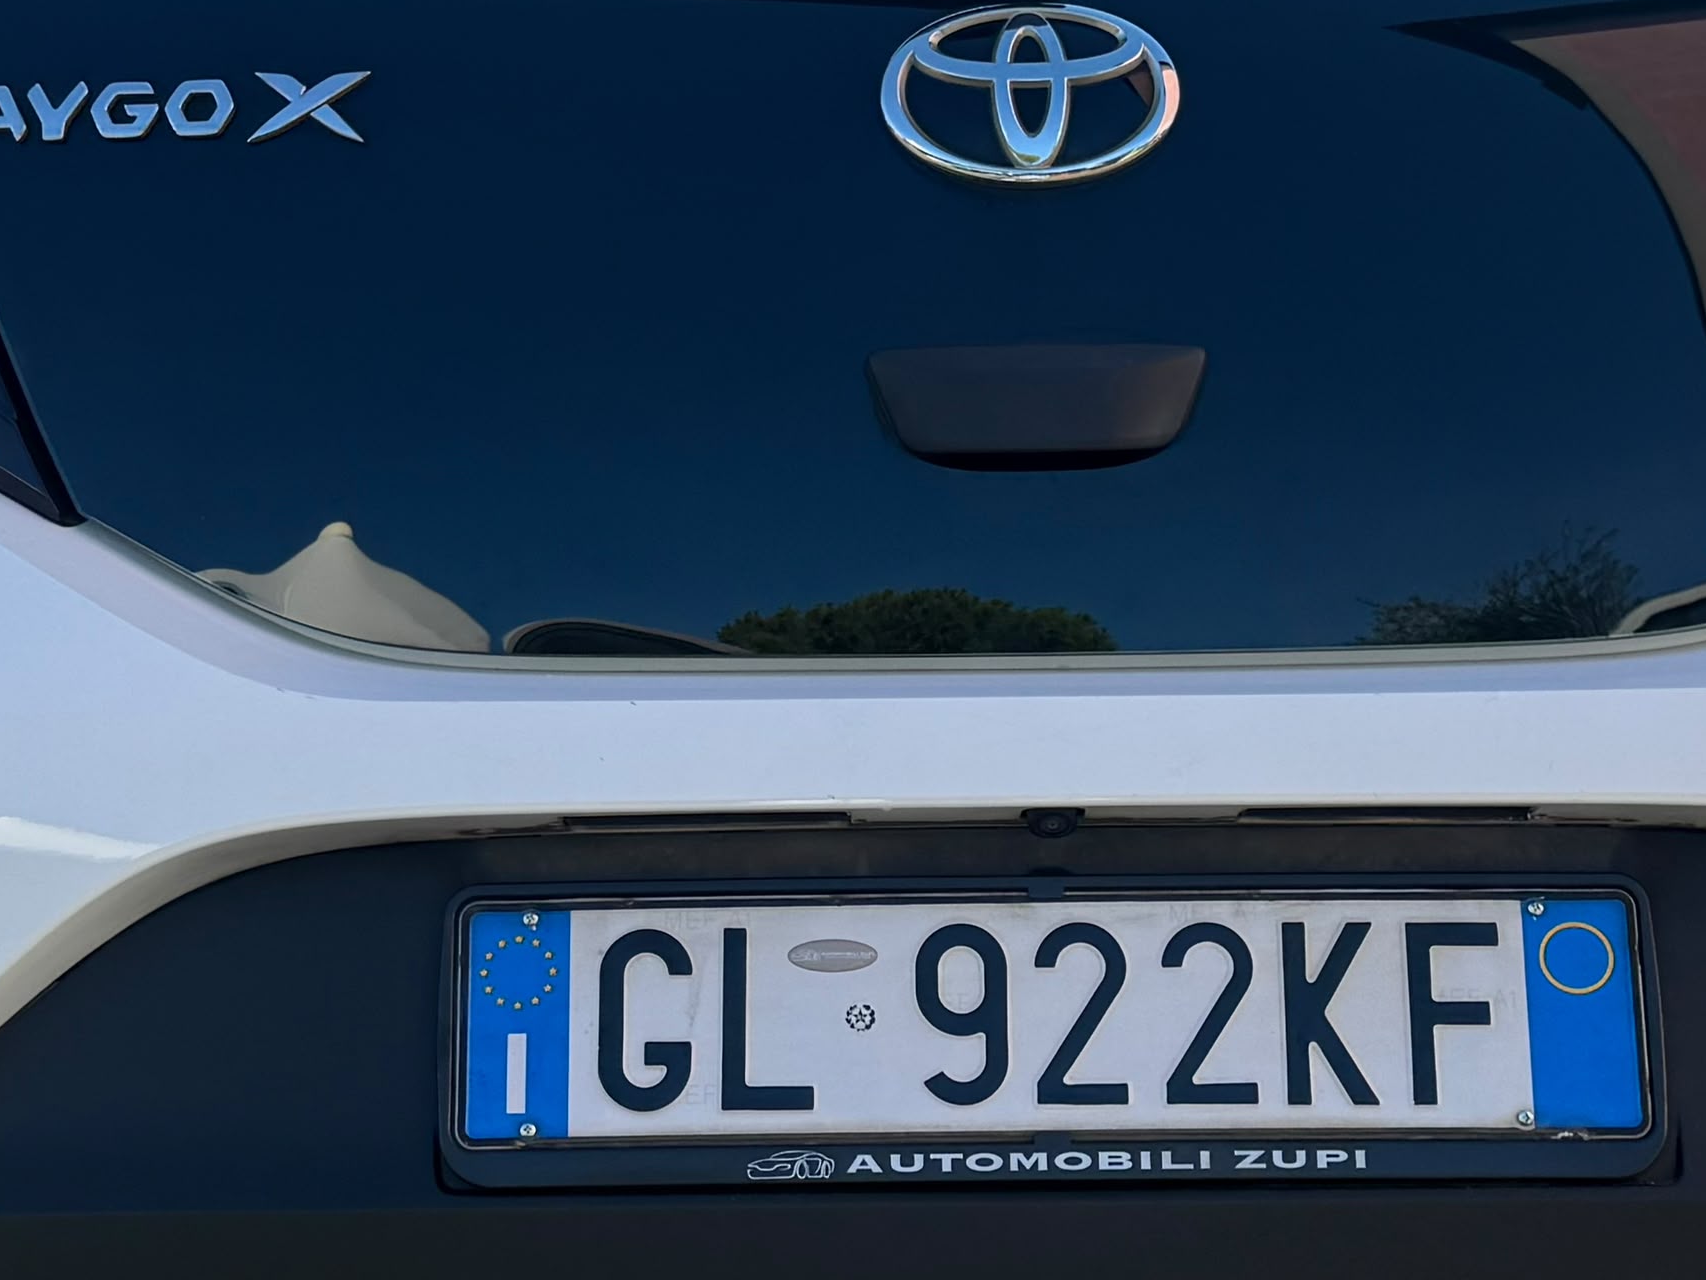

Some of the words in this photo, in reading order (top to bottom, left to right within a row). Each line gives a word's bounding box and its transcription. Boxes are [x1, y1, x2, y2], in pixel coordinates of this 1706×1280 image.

[247, 71, 372, 143] X
[597, 927, 815, 1112] GL
[914, 921, 1499, 1106] 922KF
[847, 1151, 1211, 1174] AUTOMOBILI
[1234, 1149, 1367, 1170] ZUPI
